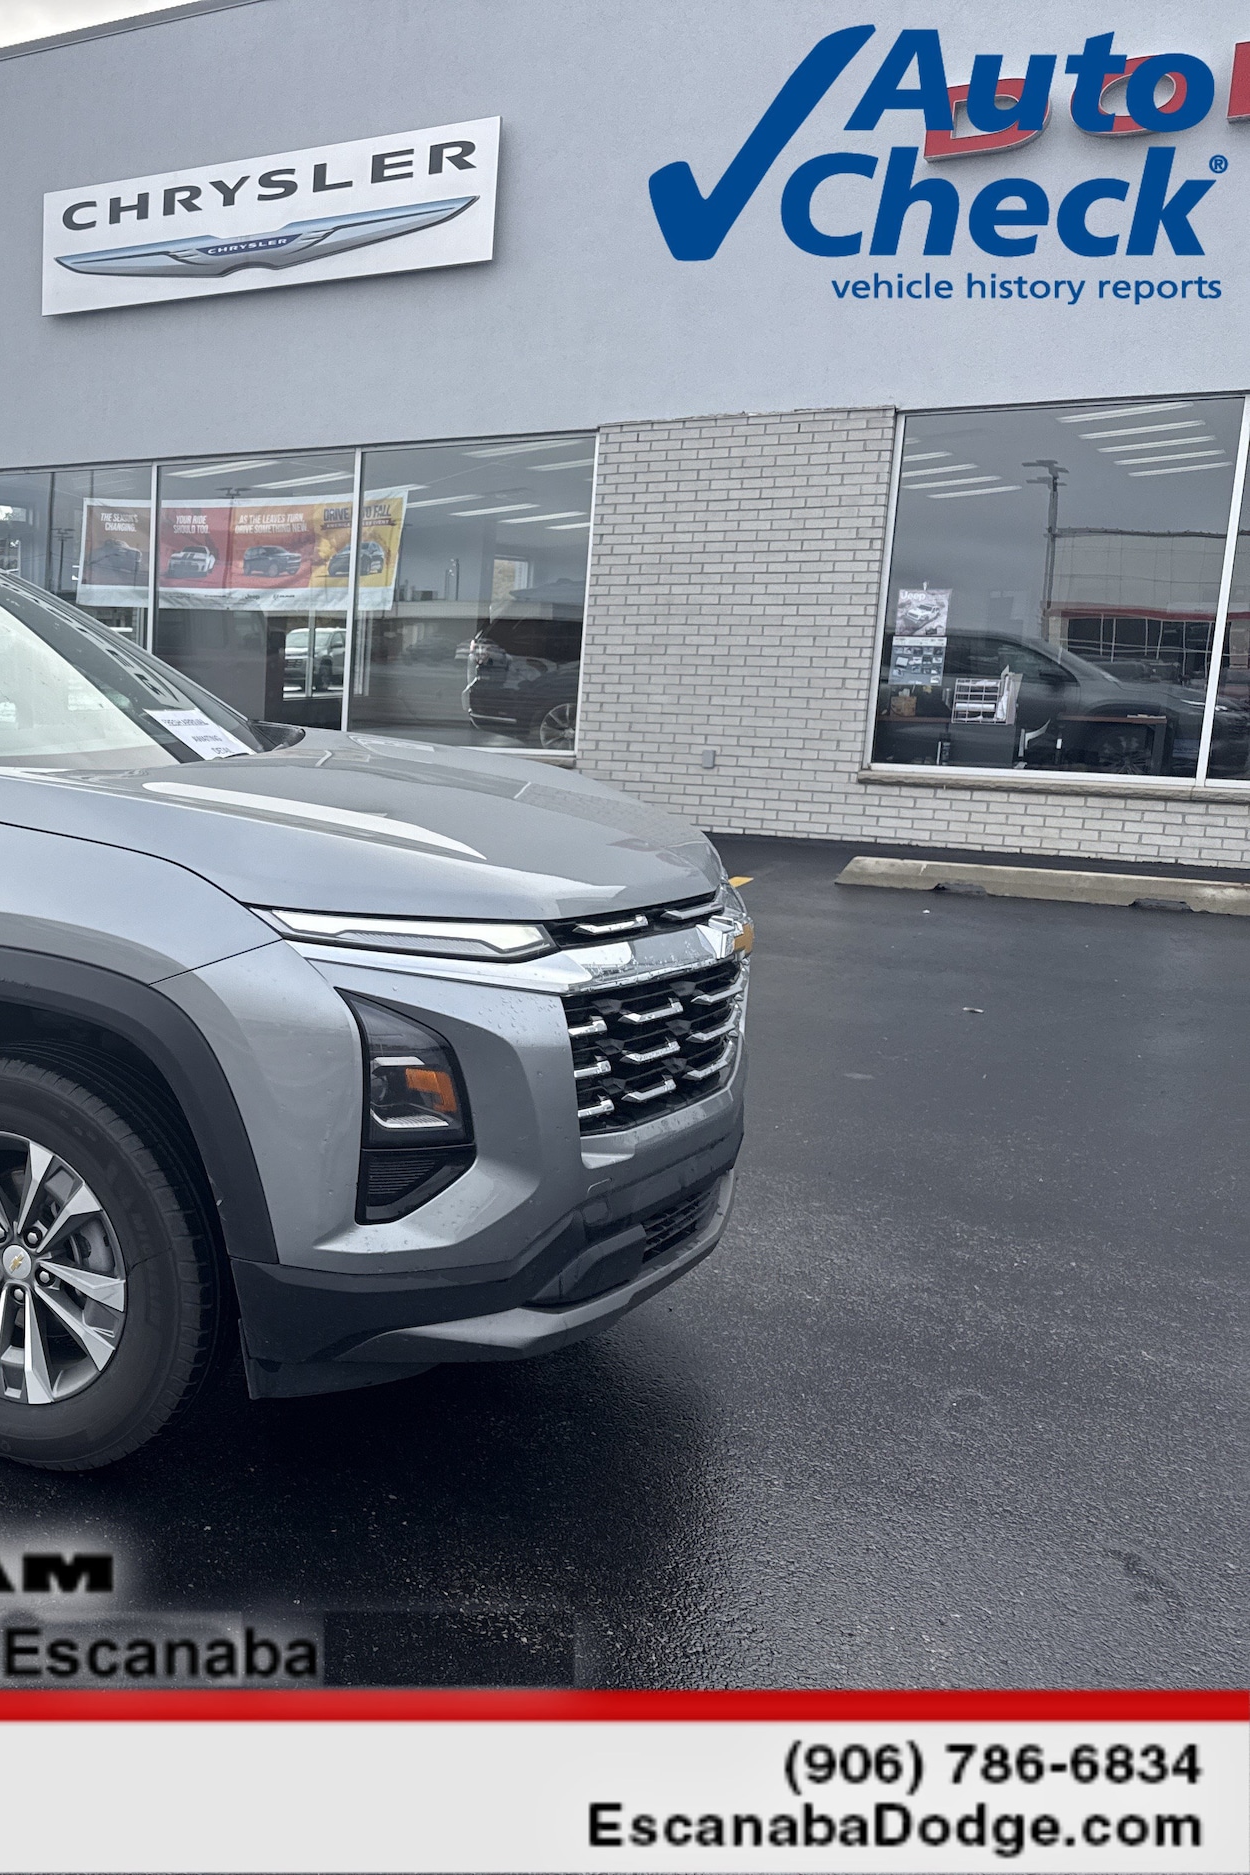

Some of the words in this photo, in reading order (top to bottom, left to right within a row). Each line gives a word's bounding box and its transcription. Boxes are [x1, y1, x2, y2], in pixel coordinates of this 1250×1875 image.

[61, 139, 477, 231] CHRYSLER
[207, 237, 288, 256] CHRYSLER
[900, 590, 926, 602] Jeep
